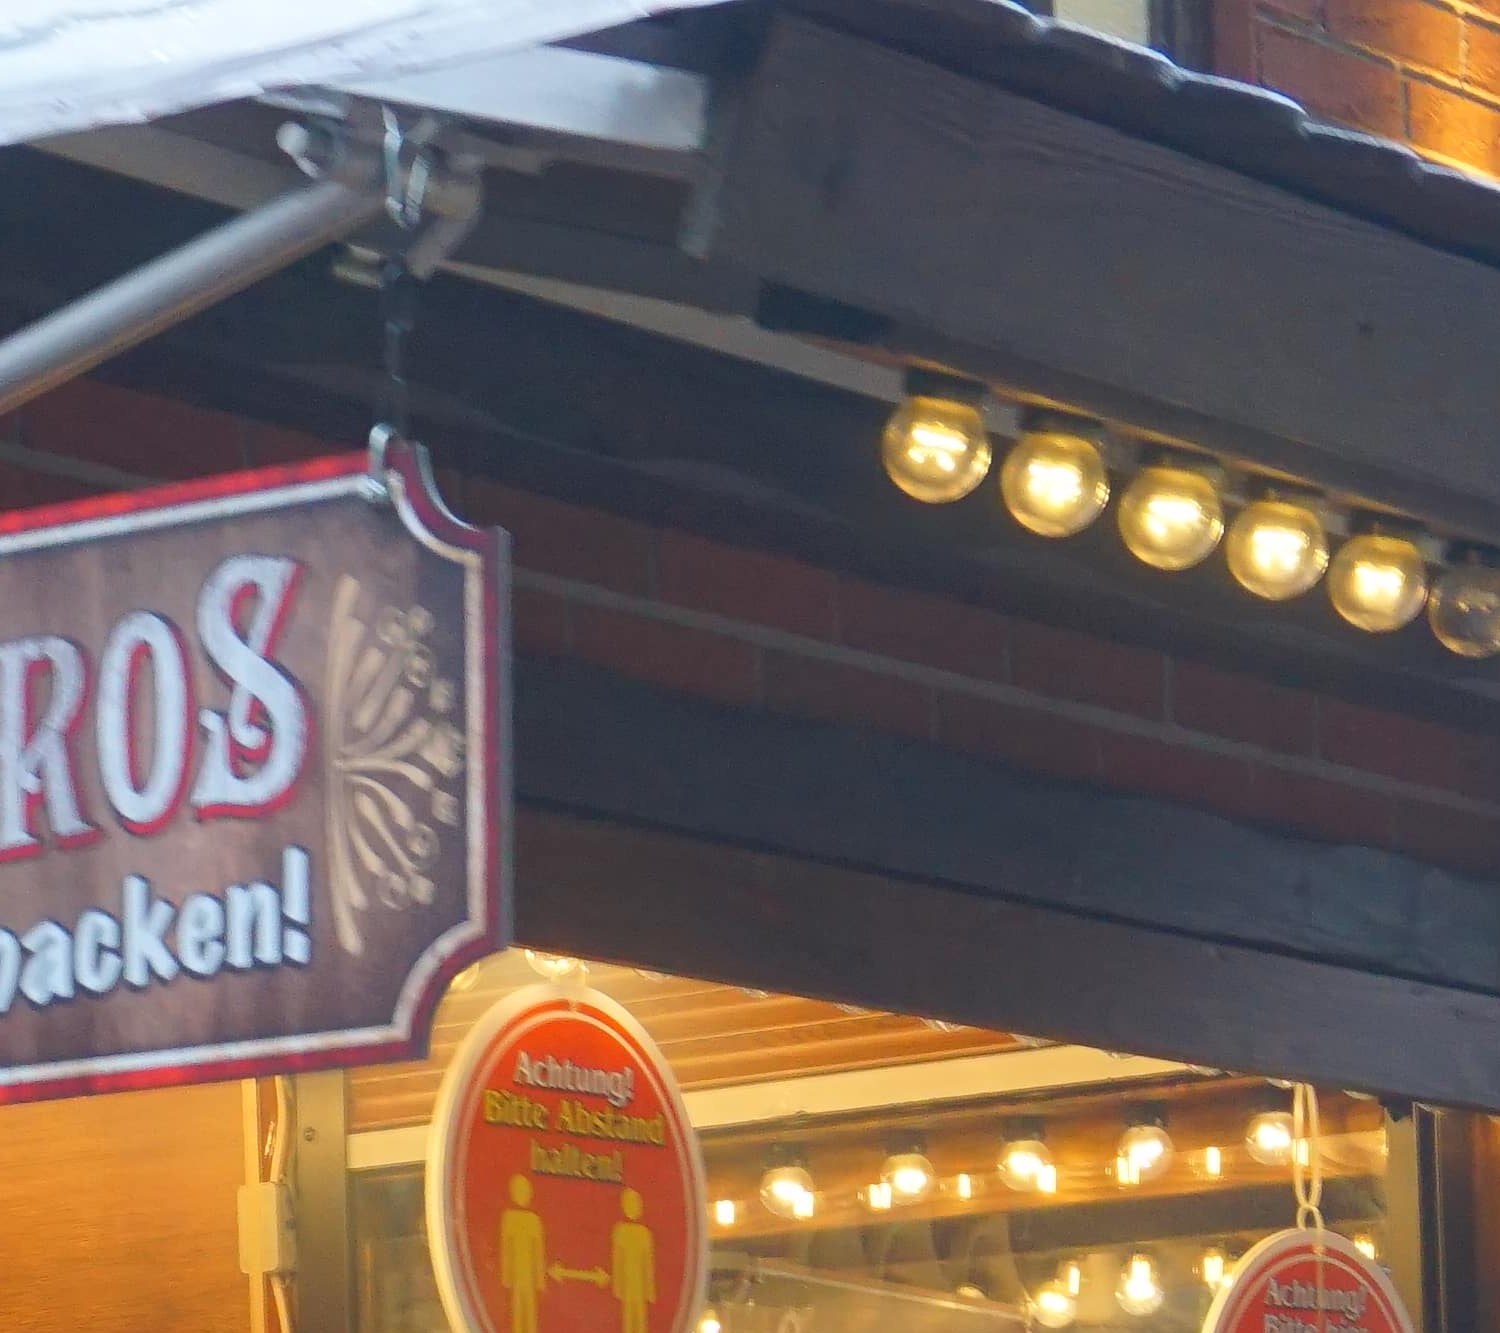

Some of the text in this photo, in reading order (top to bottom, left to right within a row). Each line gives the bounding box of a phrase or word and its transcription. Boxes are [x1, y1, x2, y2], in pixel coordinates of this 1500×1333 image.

[512, 1049, 636, 1108] Achtung!
[483, 1089, 667, 1147] Bitte Abstand
